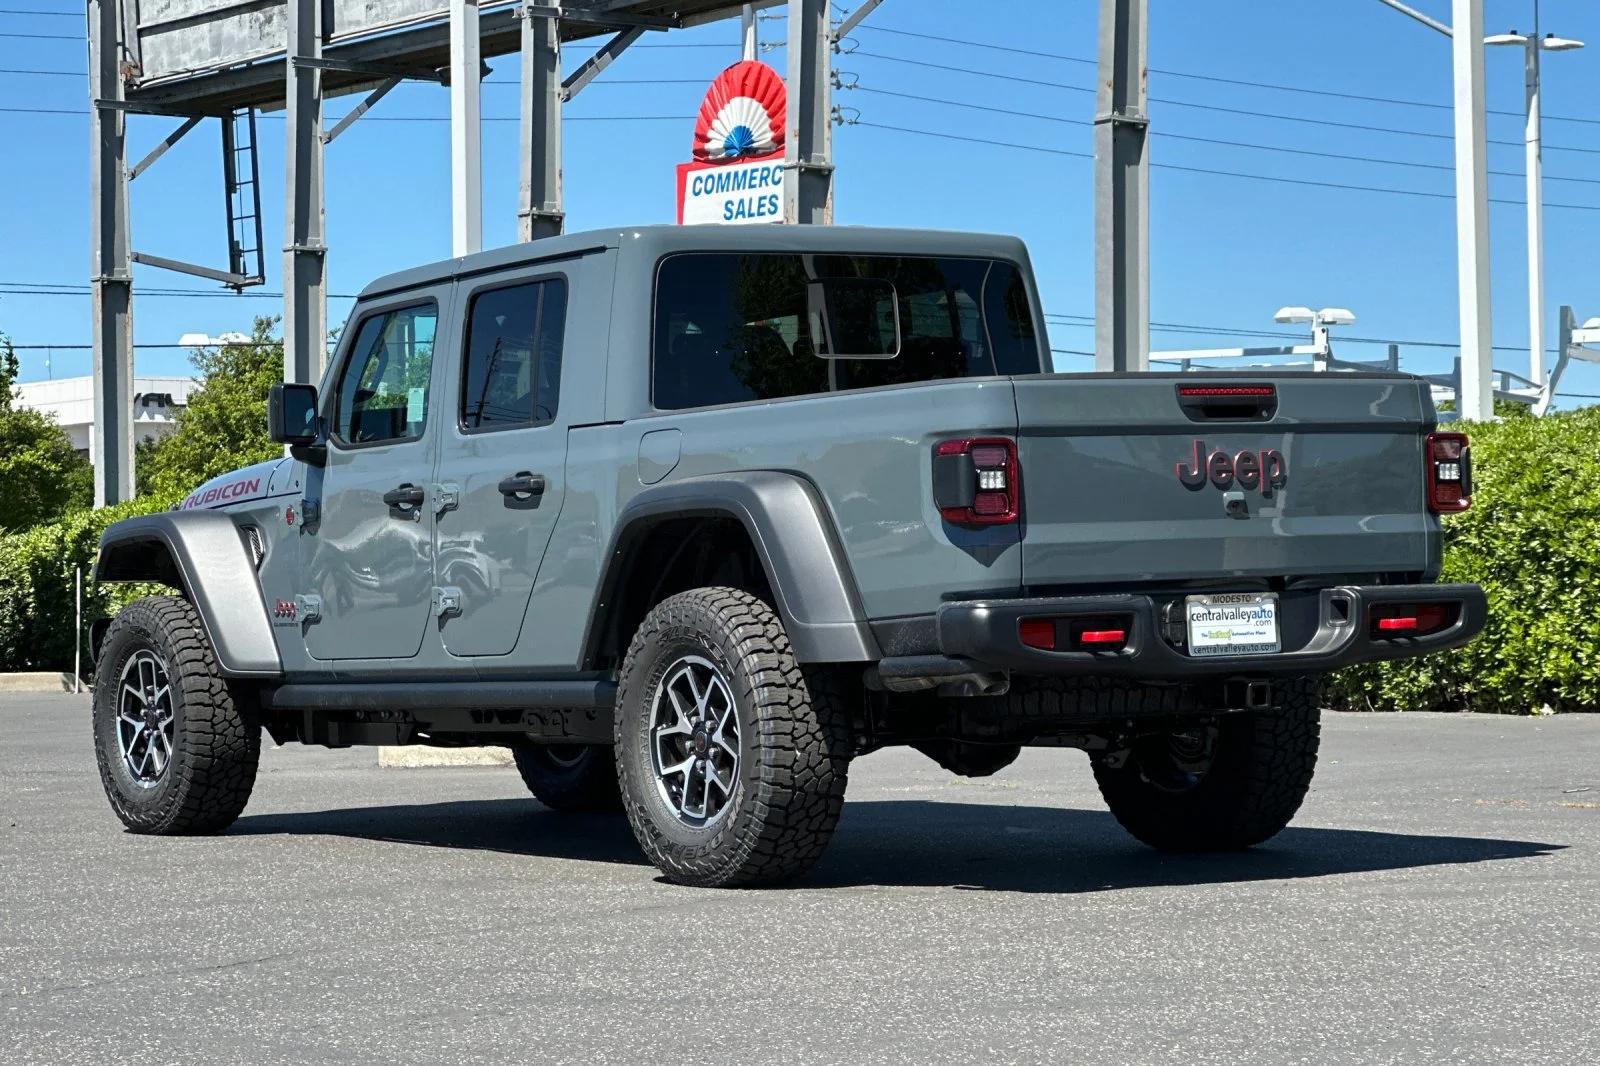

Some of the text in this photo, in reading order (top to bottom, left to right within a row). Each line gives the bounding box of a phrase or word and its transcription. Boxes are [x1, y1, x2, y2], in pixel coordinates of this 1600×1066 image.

[723, 194, 779, 221] SALES
[1175, 439, 1287, 496] Jeep
[183, 478, 261, 510] RUBICON
[1212, 594, 1252, 604] MODESTO
[274, 598, 297, 620] Jeep
[1191, 607, 1273, 623] centralvalleyauto
[1253, 619, 1272, 627] .com
[1193, 643, 1277, 654] centralvalleyauto.com
